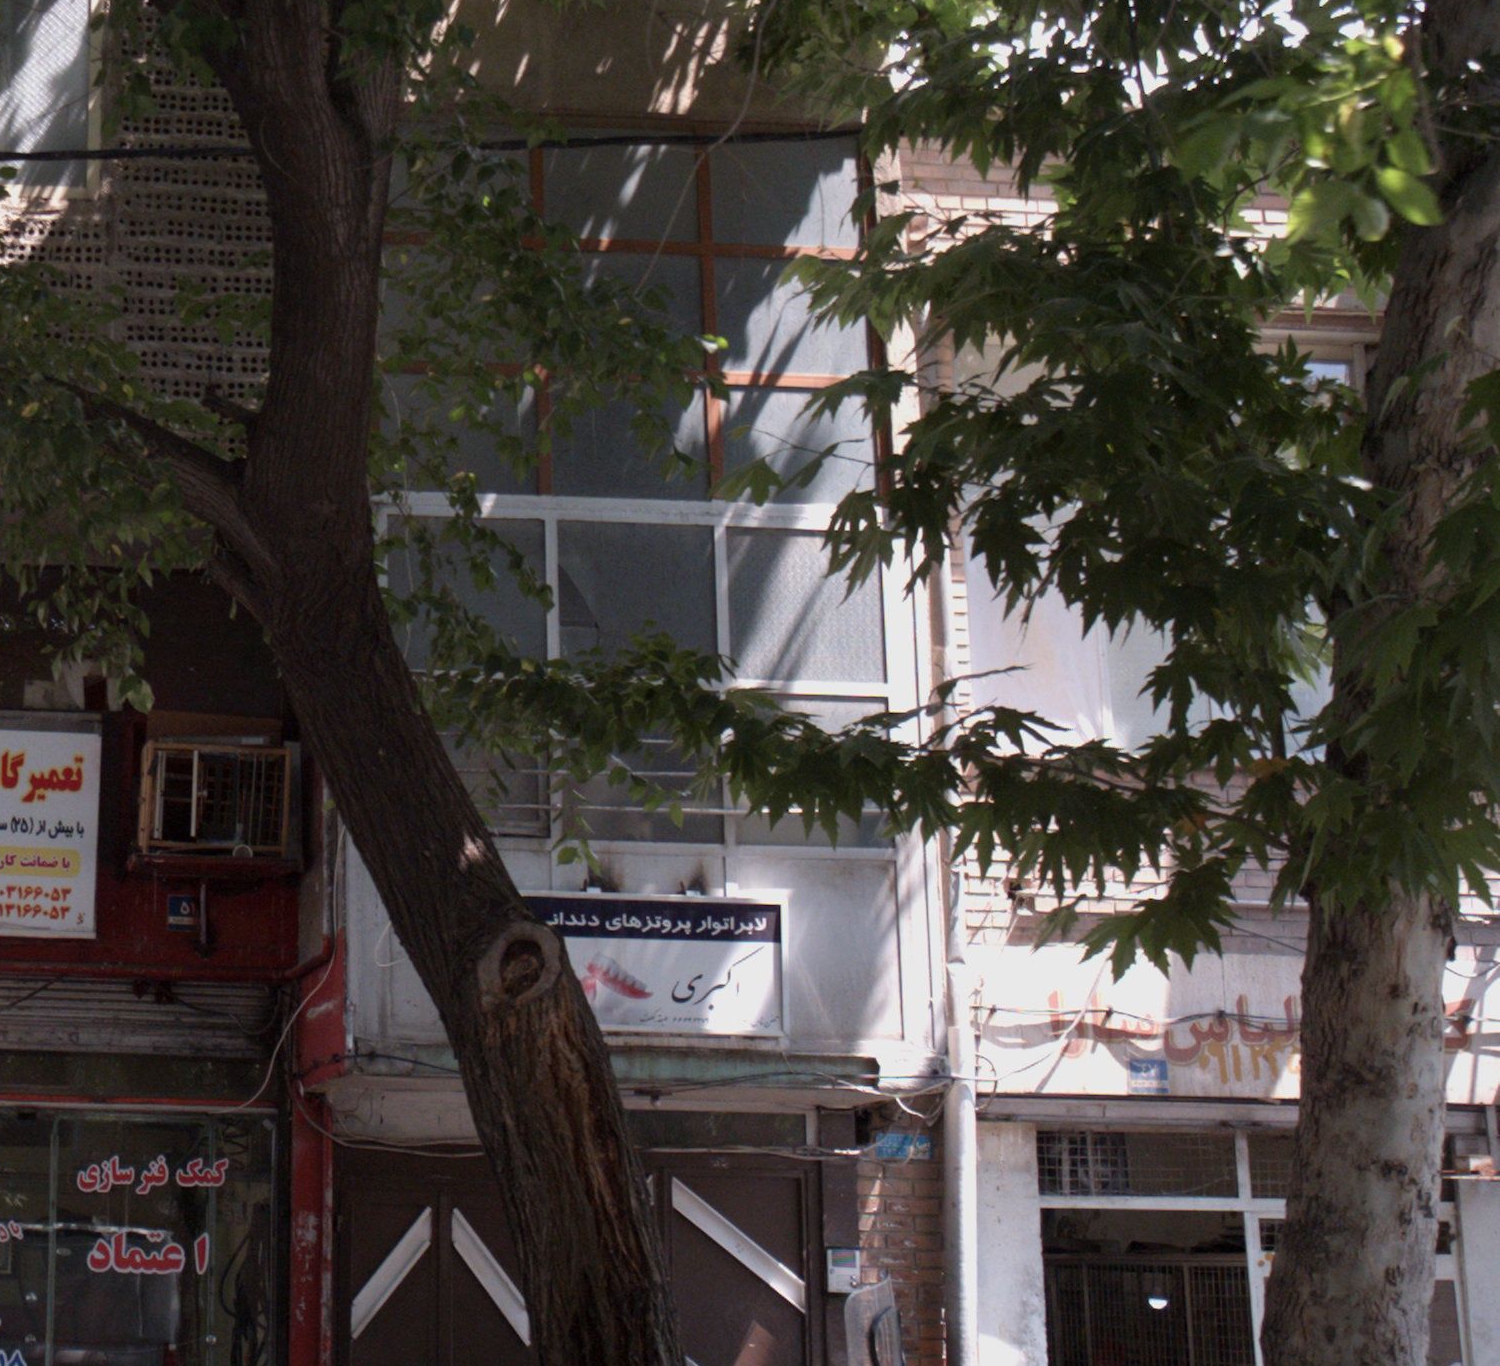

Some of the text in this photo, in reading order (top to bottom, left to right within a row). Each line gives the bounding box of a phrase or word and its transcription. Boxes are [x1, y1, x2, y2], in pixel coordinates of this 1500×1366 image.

[35, 819, 46, 836] از
[47, 822, 76, 840] بیش
[20, 853, 59, 869] ضمانت
[61, 856, 71, 871] با
[604, 913, 692, 935] پروتزهای
[696, 915, 768, 936] لابراتوار
[76, 1154, 230, 1195] کمک فنر سازی
[8, 1220, 24, 1240] با
